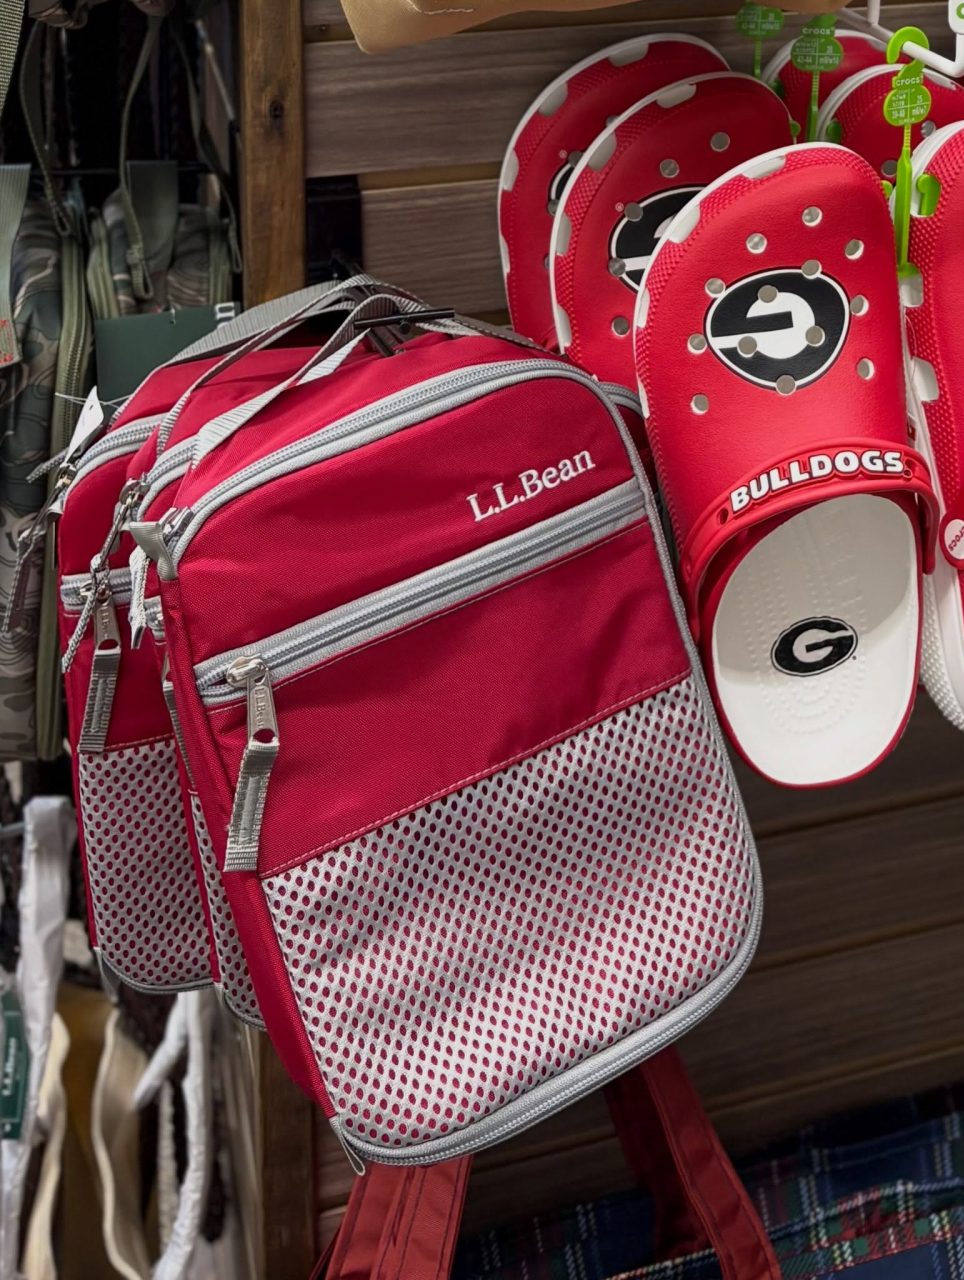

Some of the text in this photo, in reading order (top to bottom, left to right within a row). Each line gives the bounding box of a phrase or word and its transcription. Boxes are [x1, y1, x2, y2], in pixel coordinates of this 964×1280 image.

[802, 27, 831, 35] crocs
[895, 77, 921, 87] crocs
[466, 449, 596, 522] L.L.Bean
[730, 451, 904, 513] BULLDOGS
